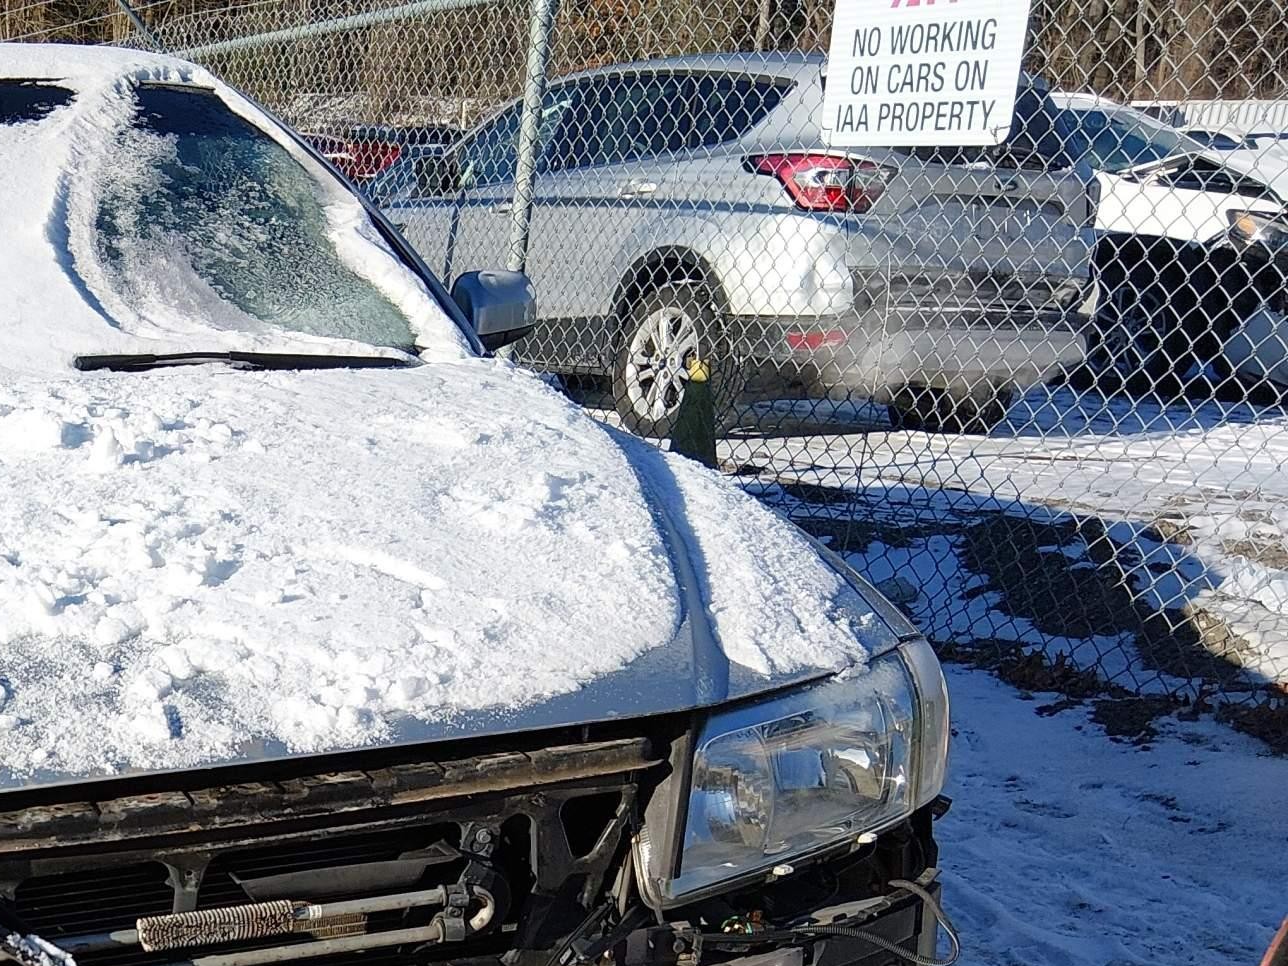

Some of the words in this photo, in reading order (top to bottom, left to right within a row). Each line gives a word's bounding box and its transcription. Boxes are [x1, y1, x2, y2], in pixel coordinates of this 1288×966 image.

[852, 27, 881, 57] NO
[890, 18, 998, 55] WORKING
[850, 66, 880, 95] ON
[887, 62, 946, 94] CARS
[954, 60, 989, 92] ON
[835, 103, 869, 132] IAA
[877, 100, 996, 132] PROPERTY
